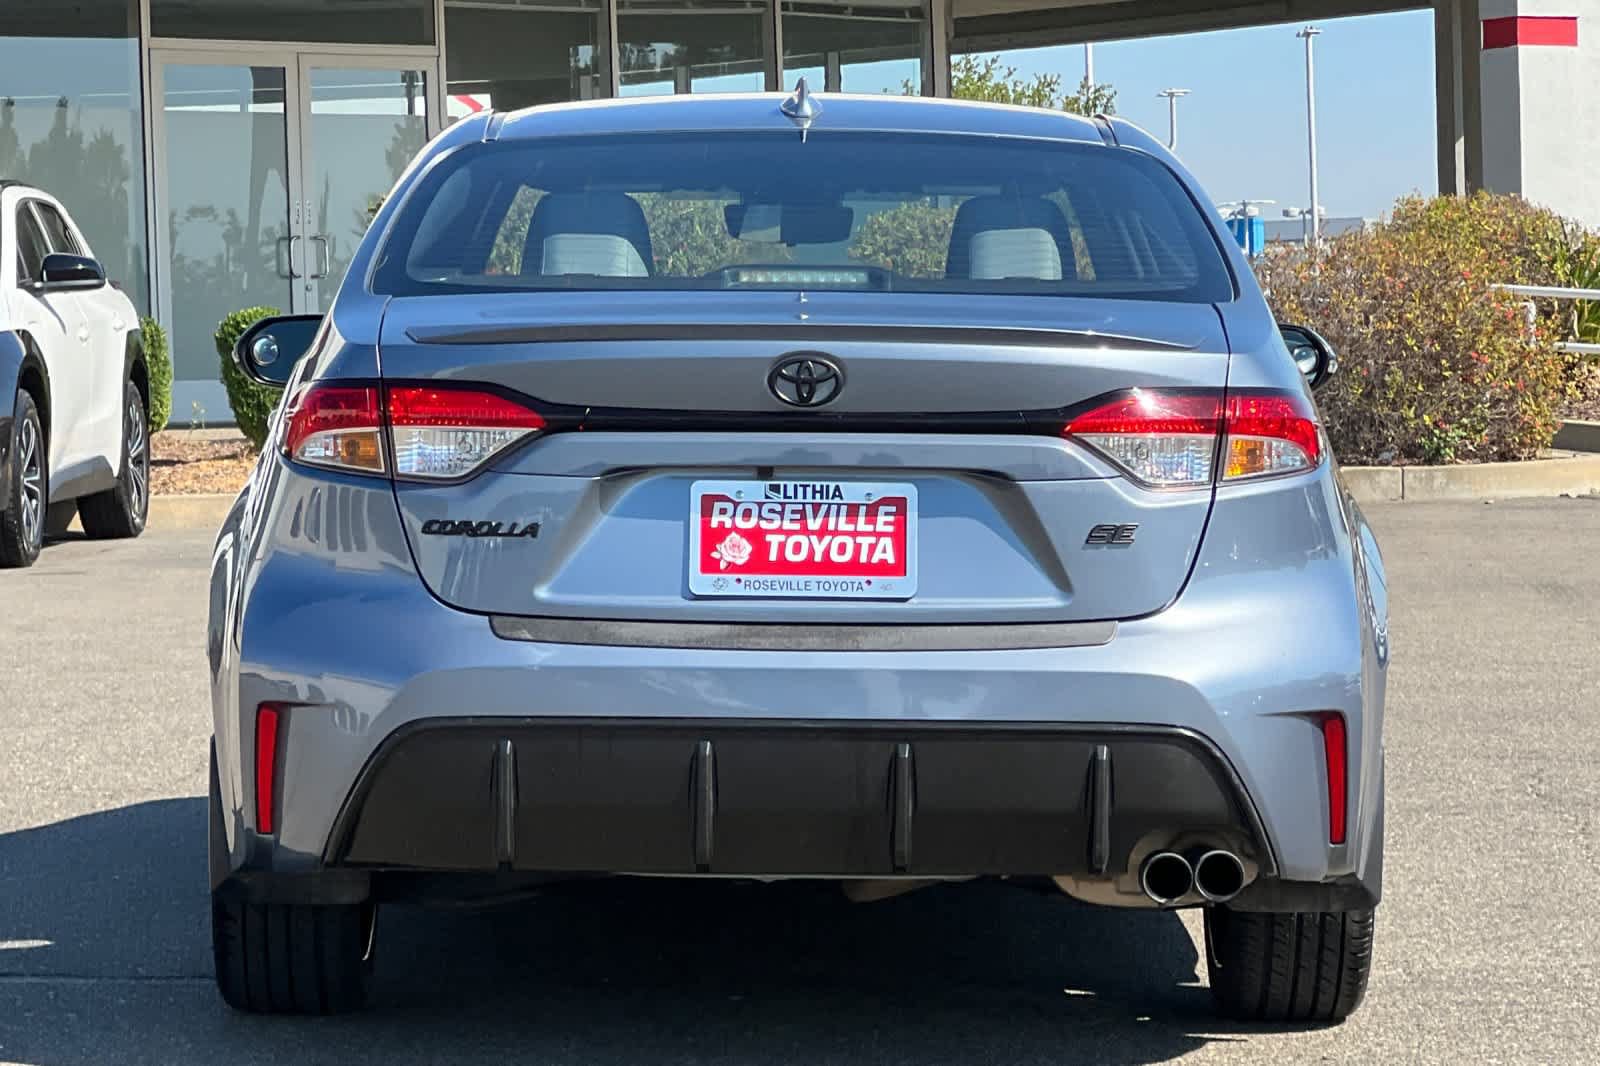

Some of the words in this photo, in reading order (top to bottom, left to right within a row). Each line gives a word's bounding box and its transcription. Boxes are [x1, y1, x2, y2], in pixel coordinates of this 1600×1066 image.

[783, 484, 843, 500] LITHIA
[710, 502, 897, 532] ROSEVILLE
[421, 519, 540, 538] COROLLA
[1085, 523, 1139, 545] SE
[765, 534, 896, 564] TOYOTA
[743, 579, 812, 592] ROSEVILLE
[815, 580, 865, 593] TOYOTA
